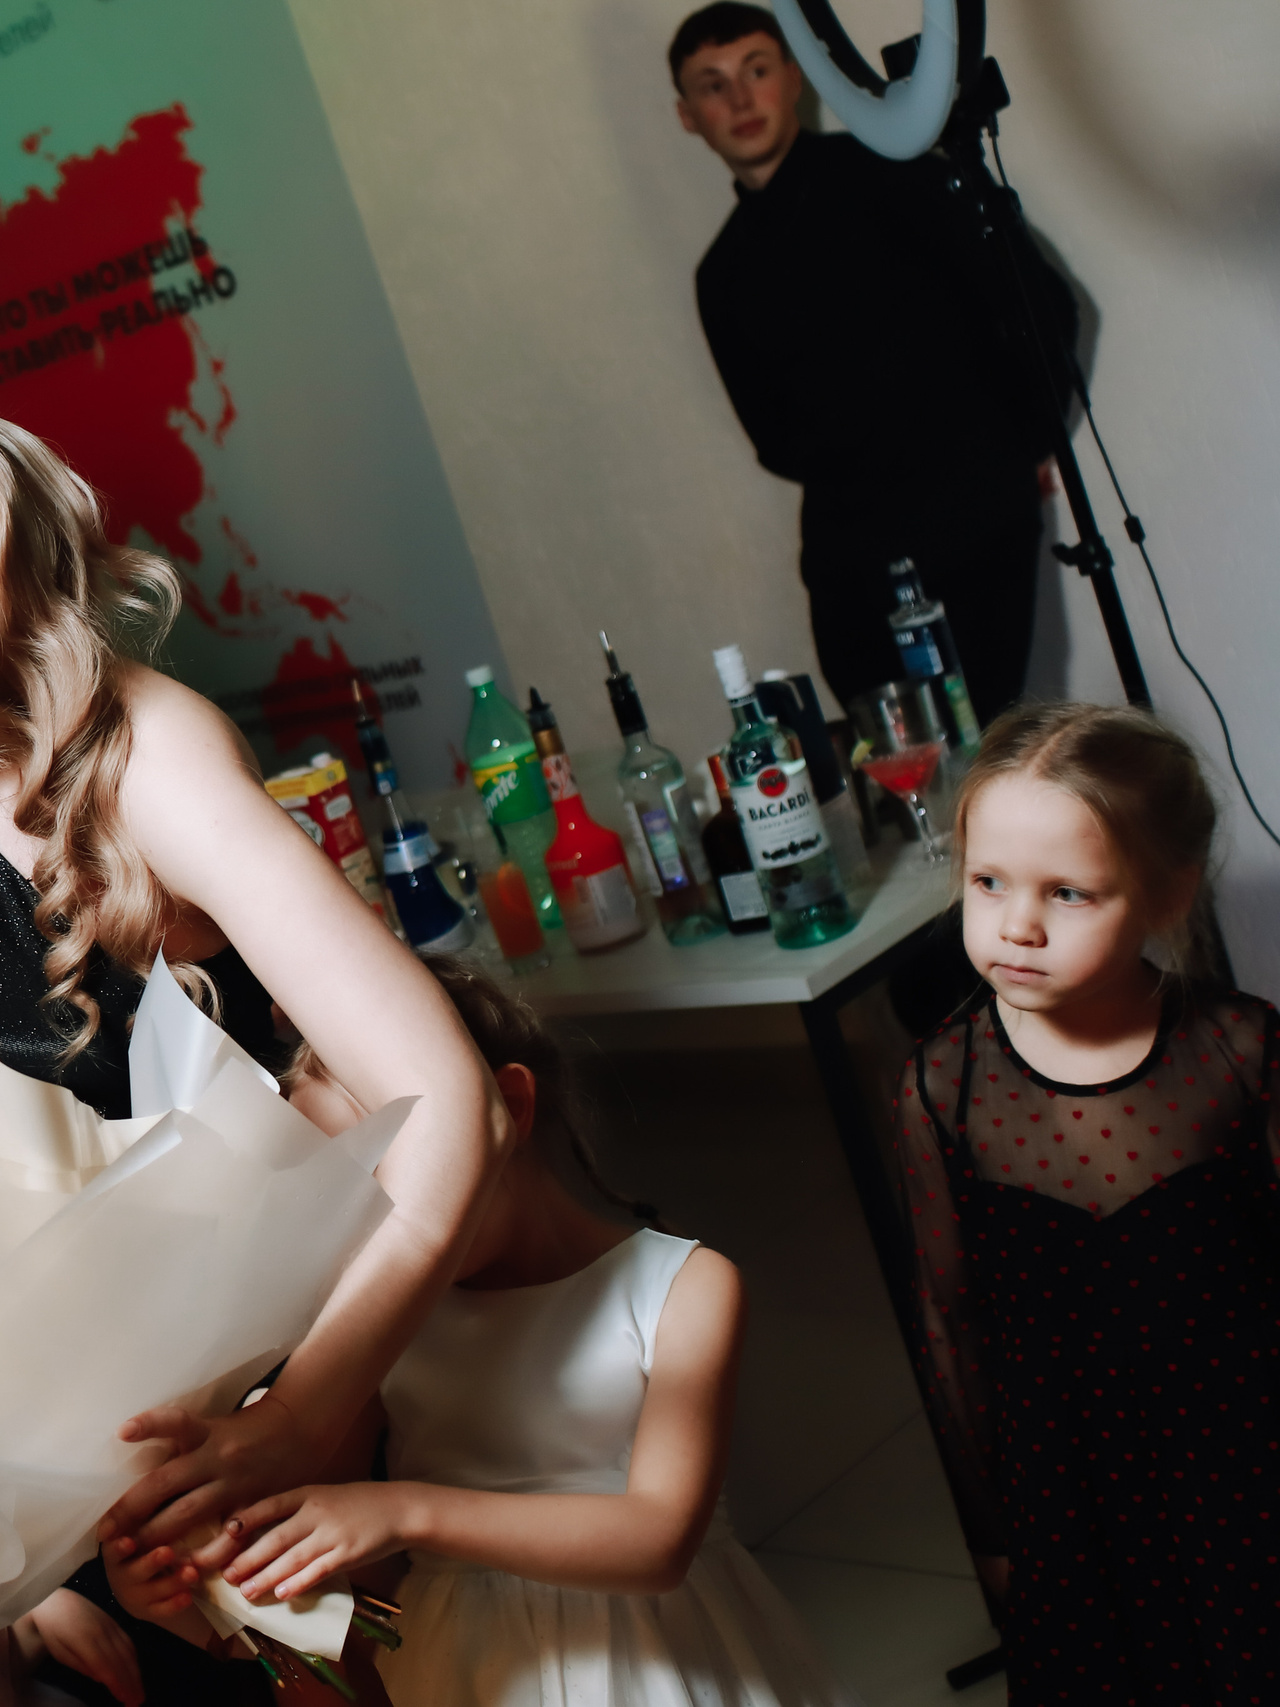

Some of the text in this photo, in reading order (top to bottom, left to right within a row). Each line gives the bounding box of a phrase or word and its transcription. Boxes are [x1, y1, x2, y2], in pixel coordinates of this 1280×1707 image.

[29, 280, 67, 317] ТЫ
[73, 228, 208, 302] МОЖЕШЬ
[99, 266, 236, 341] РЕАЛЬНО
